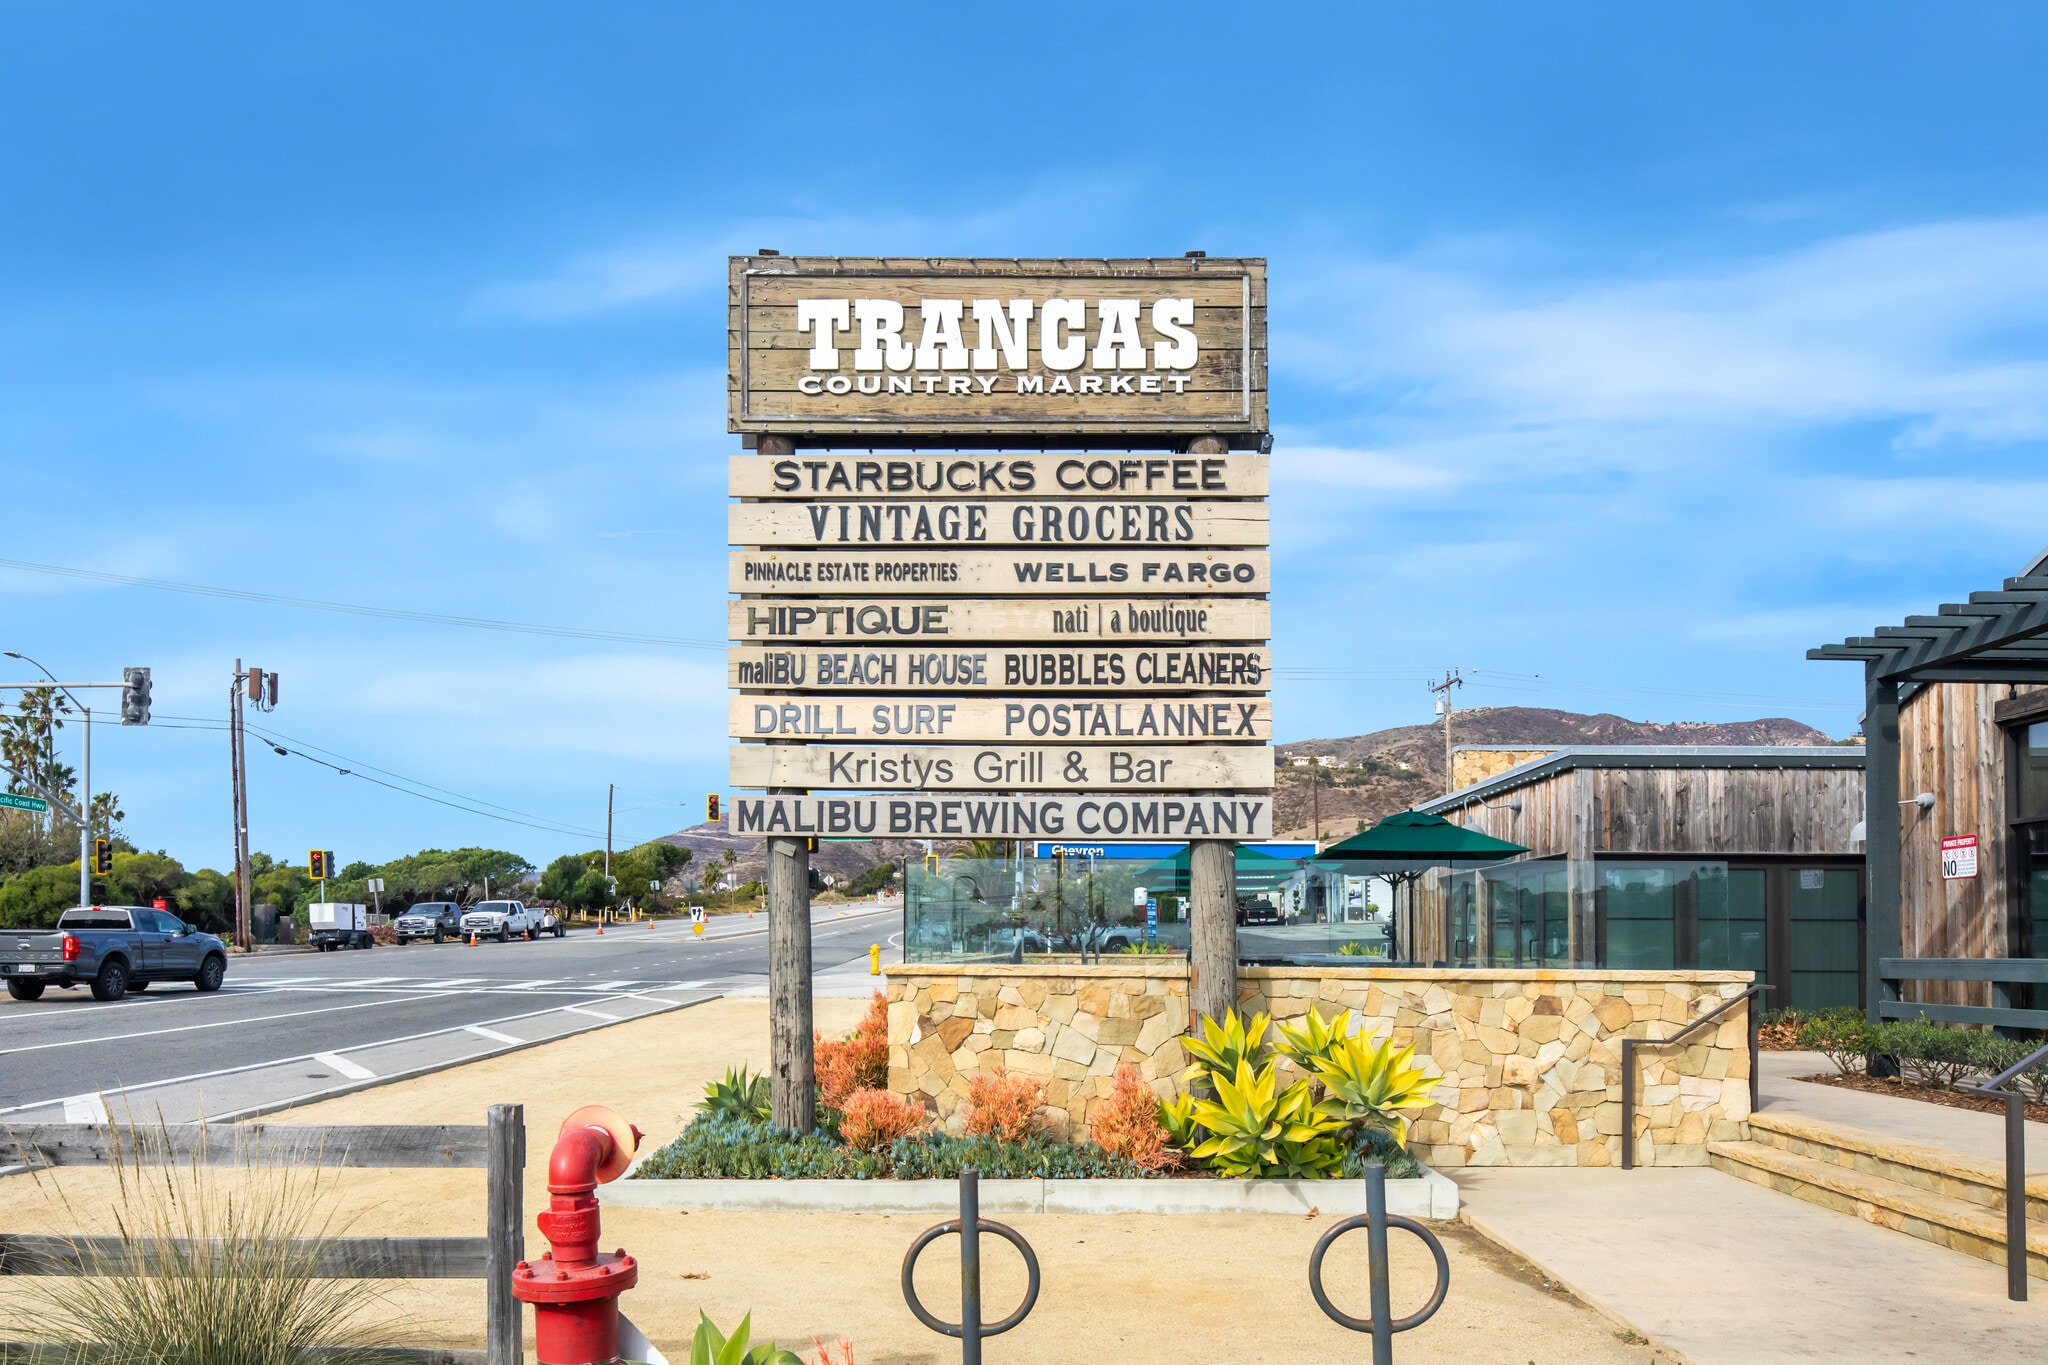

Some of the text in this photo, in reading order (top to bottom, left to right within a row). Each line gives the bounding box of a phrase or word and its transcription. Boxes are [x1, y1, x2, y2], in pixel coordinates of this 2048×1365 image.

[797, 298, 1198, 371] TRANCAS
[797, 375, 1192, 395] COUNTRY MARKET
[773, 459, 1226, 491] STARBUCKS COFFEE
[807, 505, 1195, 542] VINTAGE GROCERS
[744, 562, 958, 582] PINNACLE ESTATE PROPERTIES
[1013, 562, 1256, 583] WELLS FARGO
[747, 605, 949, 636] HIPTIQUE
[1053, 603, 1090, 634] nati
[1110, 609, 1122, 634] a
[1128, 602, 1208, 638] boutique
[738, 653, 987, 686] maliBU BEACH HOUSE
[1005, 652, 1262, 685] BUBBLES CLEANERS
[754, 704, 956, 735] DRILL SURF
[1005, 703, 1258, 736] POSTALANNEX
[829, 750, 1173, 790] Kristys Grill & Bar
[14, 798, 31, 807] Coast
[31, 800, 46, 811] Hwy
[738, 800, 1264, 835] MALIBU BREWING COMPANY
[1051, 844, 1104, 856] Chevron
[1943, 860, 1957, 876] NO
